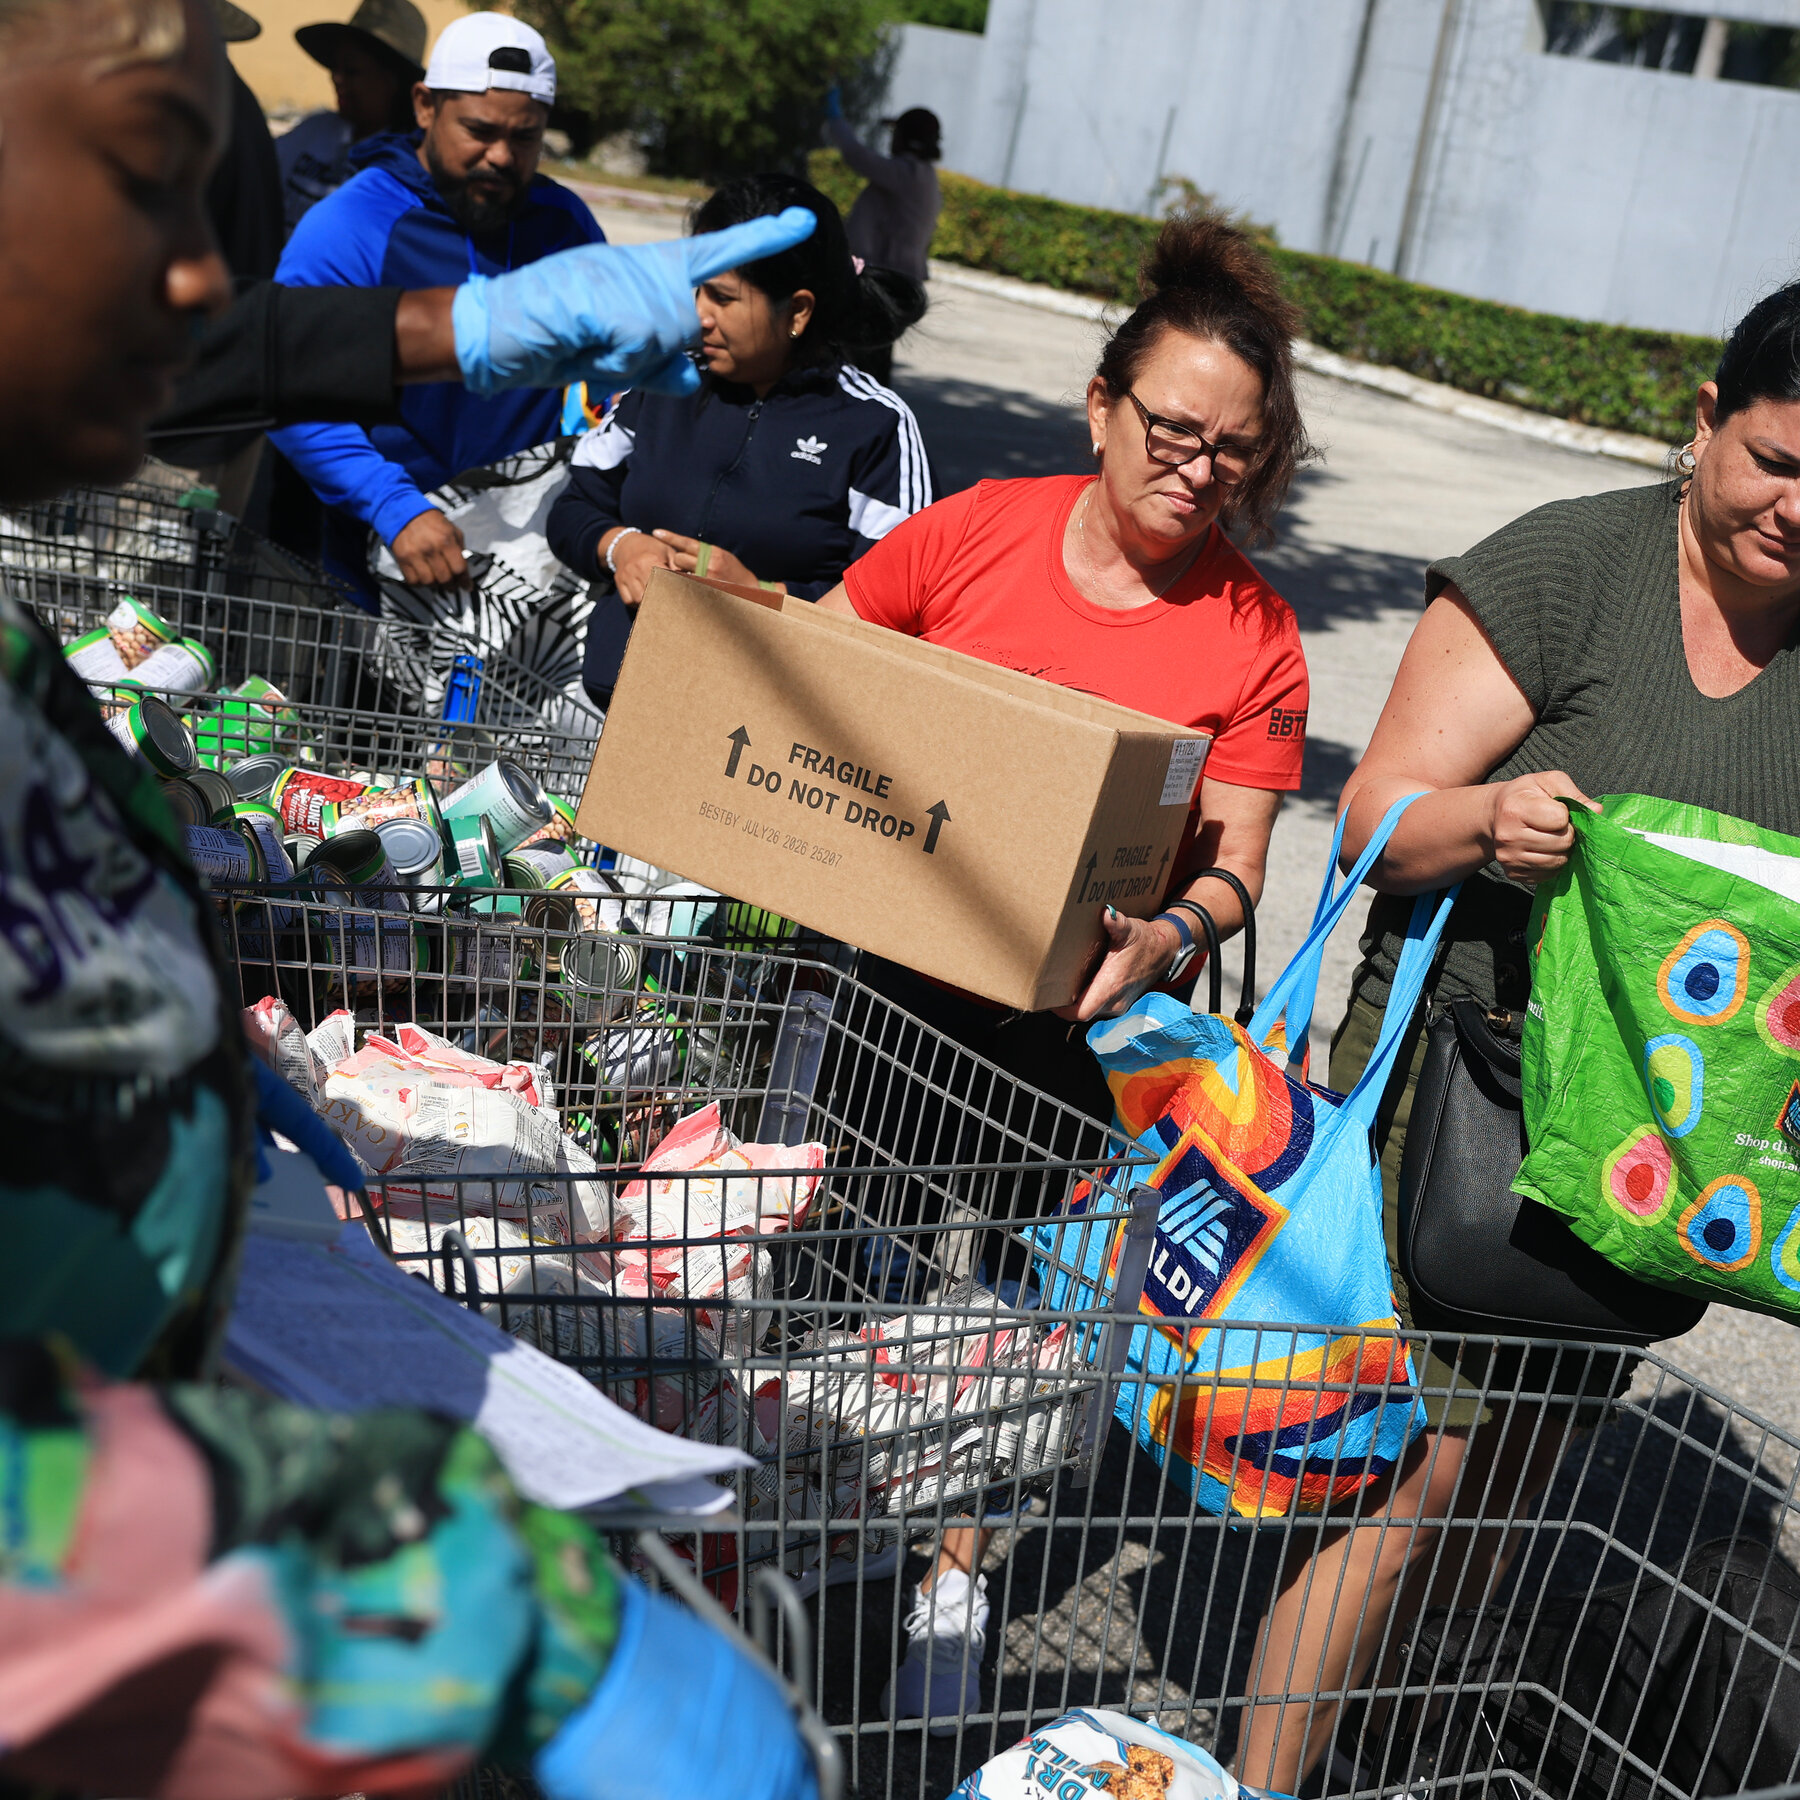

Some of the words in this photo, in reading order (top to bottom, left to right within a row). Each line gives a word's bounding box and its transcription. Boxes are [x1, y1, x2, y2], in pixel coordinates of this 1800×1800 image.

[790, 451, 822, 465] adidas
[788, 742, 893, 799] FRAGILE
[307, 794, 326, 833] KIDNEY
[747, 763, 782, 793] DO
[787, 779, 840, 815] NOT
[844, 800, 915, 842] DROP
[698, 801, 741, 828] BESTBY
[783, 835, 808, 855] 2026
[810, 846, 843, 868] 25207
[1112, 845, 1152, 868] FRAGILE
[1088, 881, 1106, 902] DO
[1104, 878, 1127, 901] NOT
[1125, 876, 1152, 898] DROP
[316, 1097, 386, 1144] CAKE
[1735, 1133, 1769, 1151] Shop
[1021, 1753, 1088, 1800] DRY
[1030, 1738, 1112, 1791] MILK
